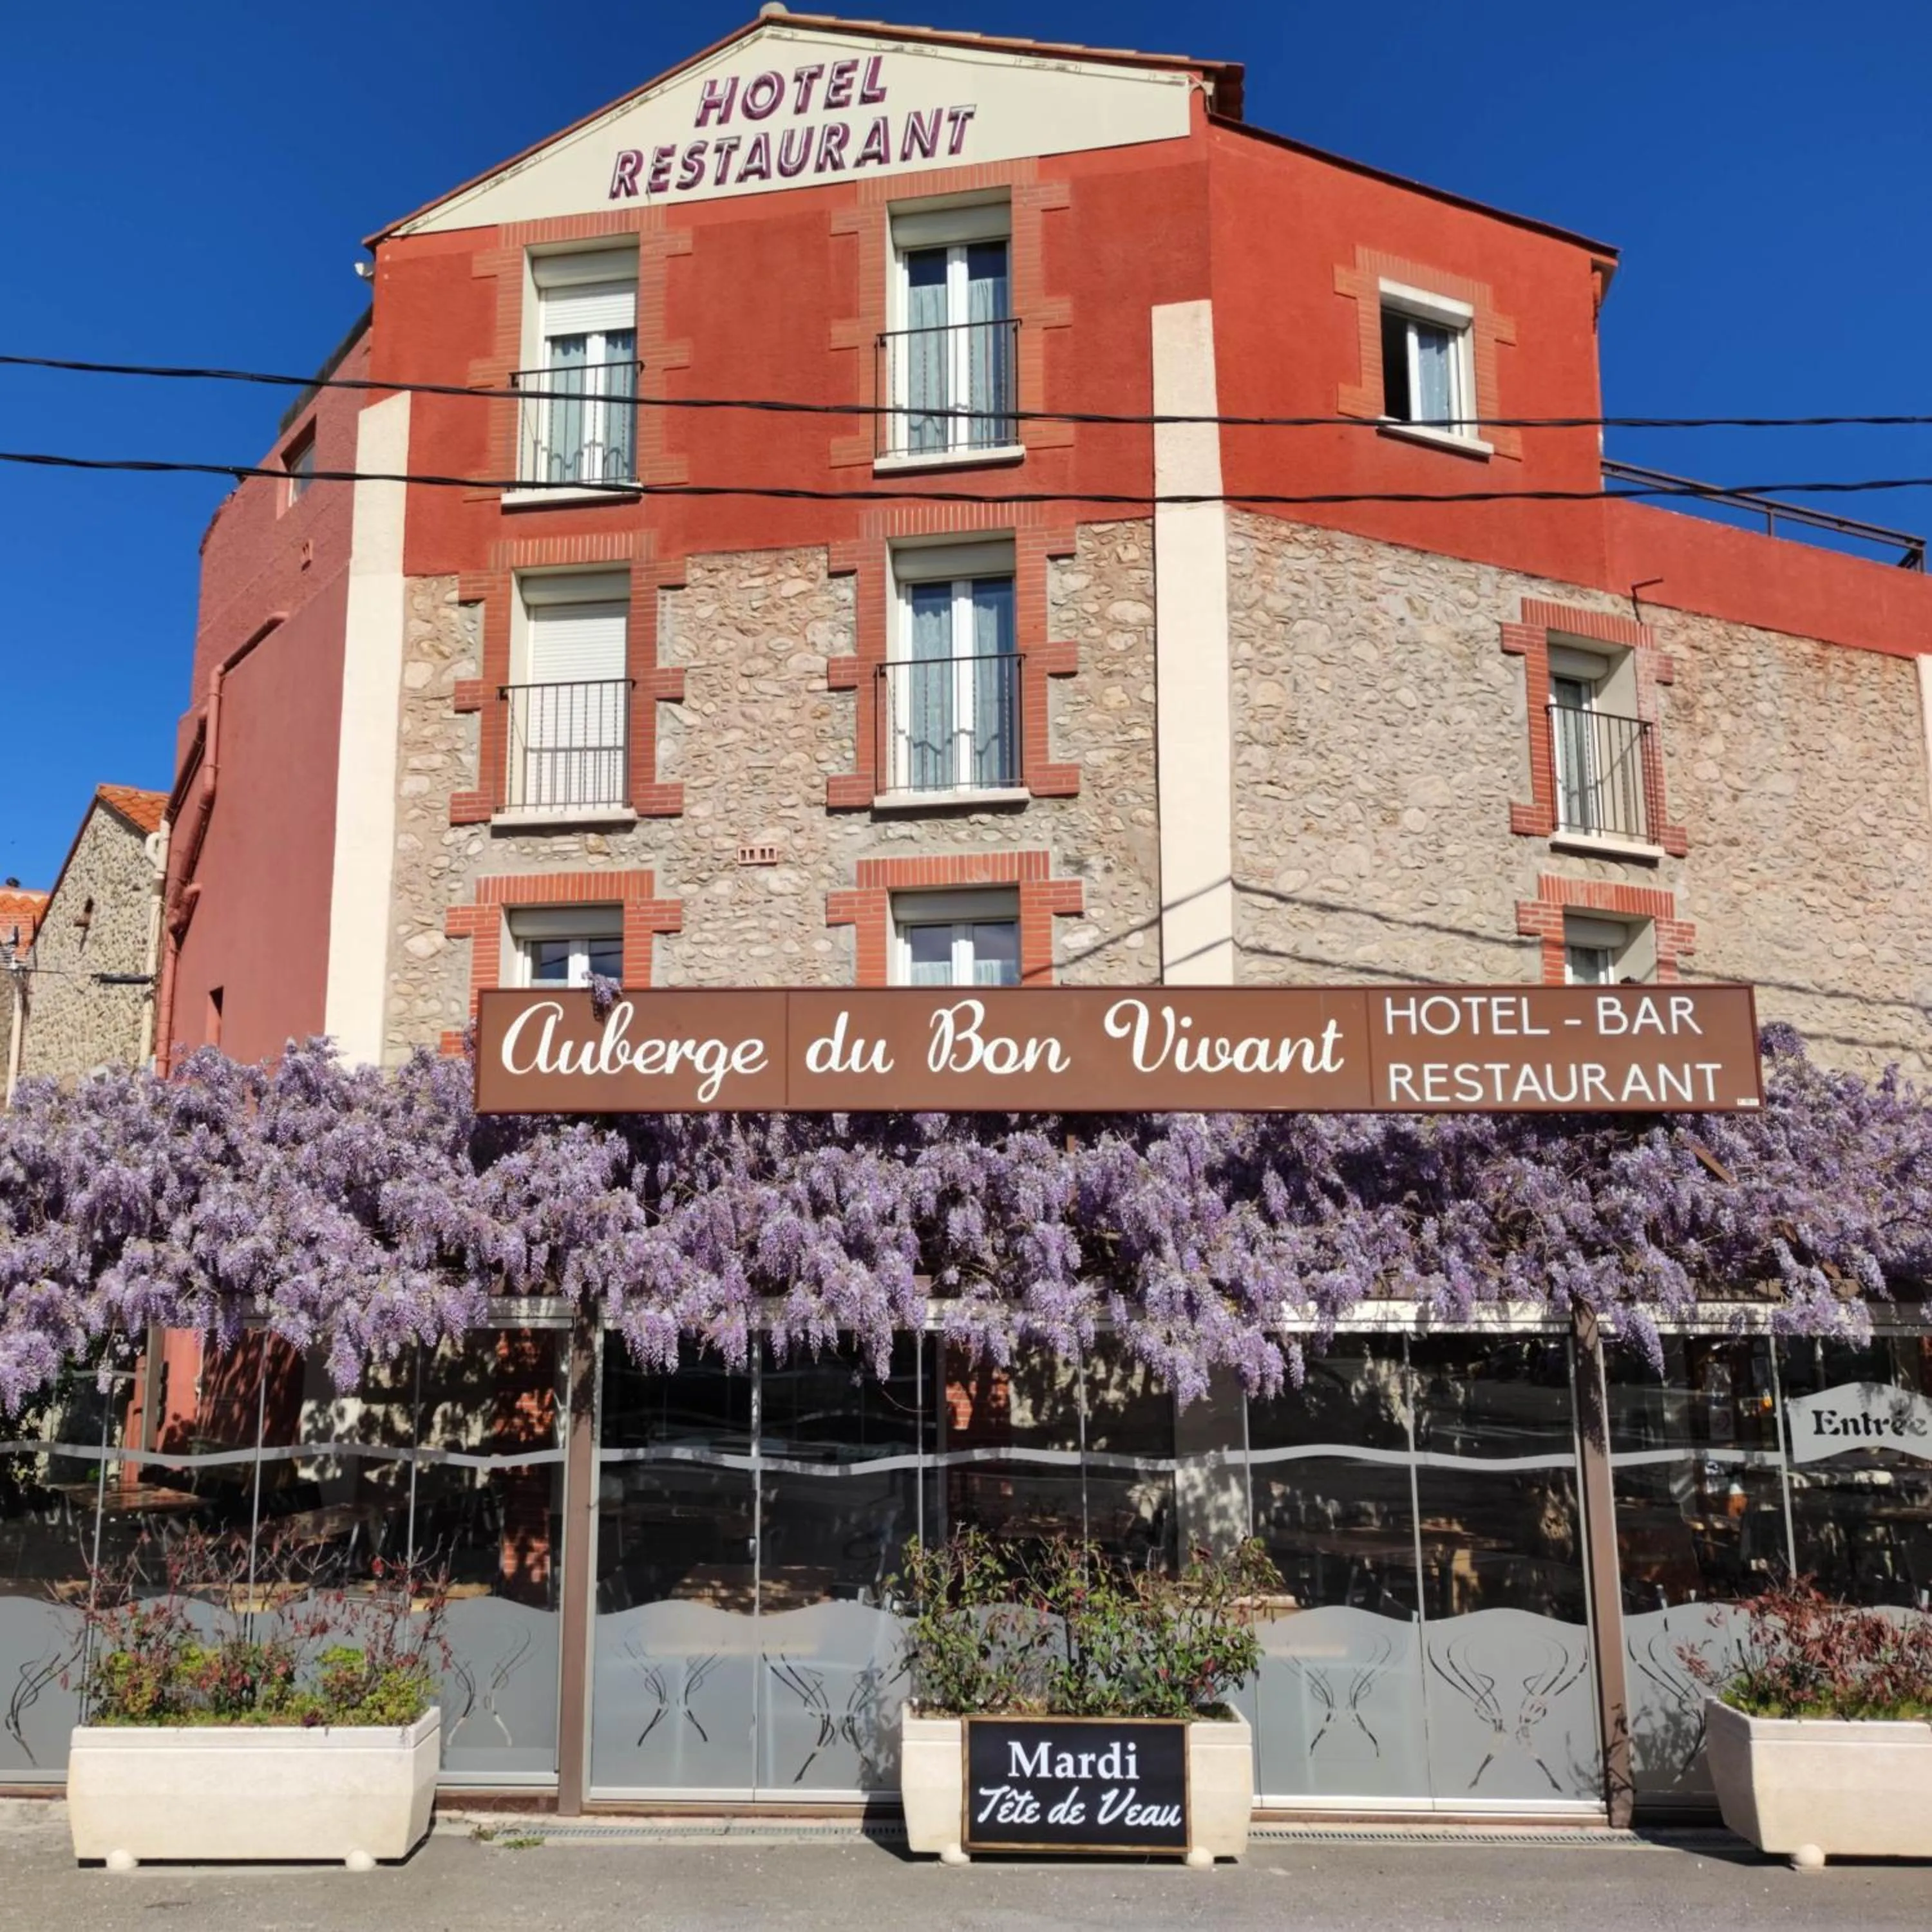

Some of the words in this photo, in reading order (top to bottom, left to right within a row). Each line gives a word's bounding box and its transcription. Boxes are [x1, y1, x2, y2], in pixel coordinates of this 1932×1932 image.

[694, 55, 887, 128] HOTEL
[609, 104, 977, 199] RESTAURANT
[1385, 996, 1549, 1036] HOTEL
[1596, 996, 1702, 1035] BAR
[501, 1001, 768, 1103] Auberge
[805, 1010, 895, 1074] du
[927, 999, 1071, 1074] Bon
[1104, 999, 1344, 1074] Vivant
[1388, 1063, 1722, 1103] RESTAURANT
[1811, 1409, 1927, 1437] Entrée
[1007, 1741, 1140, 1779] Mardi
[977, 1785, 1041, 1824] Tête
[1047, 1786, 1086, 1825] de
[1097, 1787, 1182, 1828] Veau
